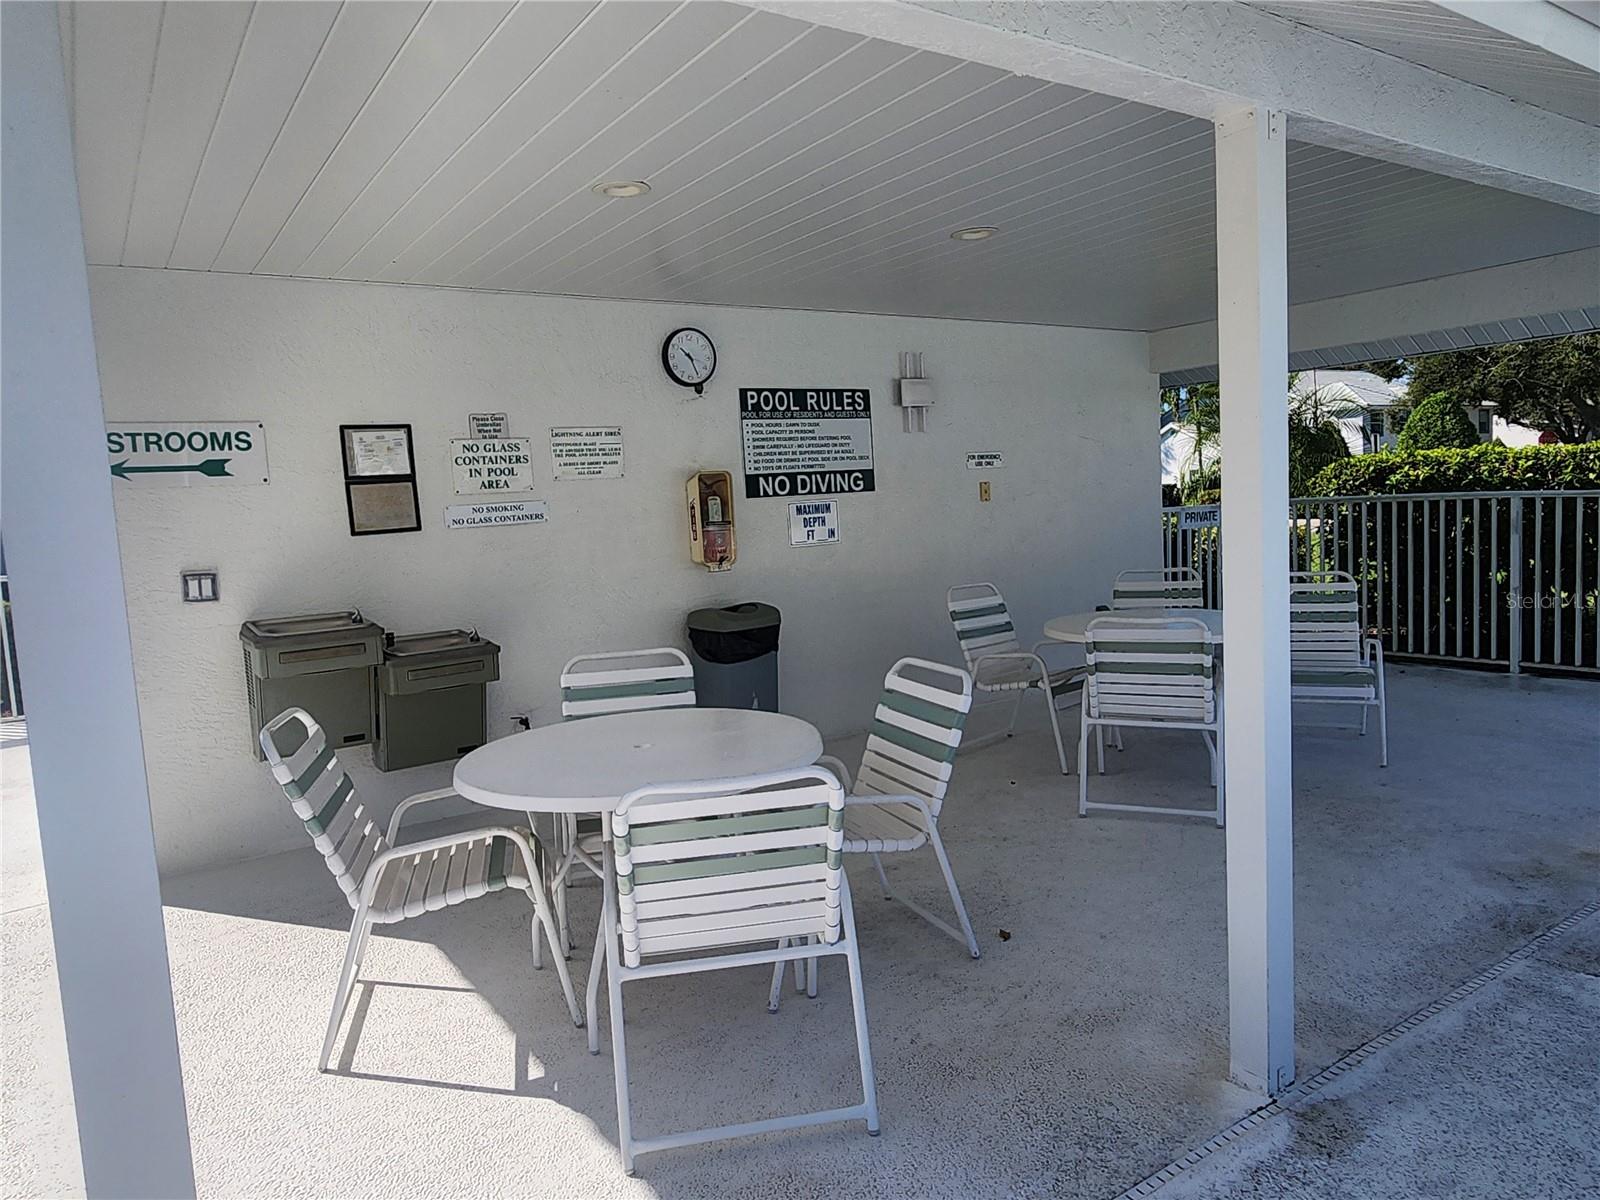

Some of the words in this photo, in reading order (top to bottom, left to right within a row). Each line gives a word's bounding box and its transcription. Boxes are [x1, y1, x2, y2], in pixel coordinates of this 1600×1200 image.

[747, 391, 800, 411] POOL
[806, 391, 864, 410] RULES
[107, 431, 252, 453] STROOMS
[462, 444, 479, 454] NO
[483, 443, 521, 453] GLASS
[455, 455, 529, 466] CONTAINERS
[469, 468, 482, 478] IN
[487, 467, 518, 477] POOL
[480, 480, 510, 490] AREA
[759, 475, 790, 496] NO
[797, 472, 864, 494] DIVING
[486, 504, 525, 513] SMOKING
[796, 503, 831, 516] MAXIMUM
[452, 518, 465, 526] NO
[466, 516, 493, 524] GLASS
[494, 513, 545, 523] CONTAINERS
[803, 516, 826, 528] DEPTH
[1184, 510, 1218, 523] PRIVATE
[806, 530, 815, 540] FT
[828, 528, 835, 538] IN
